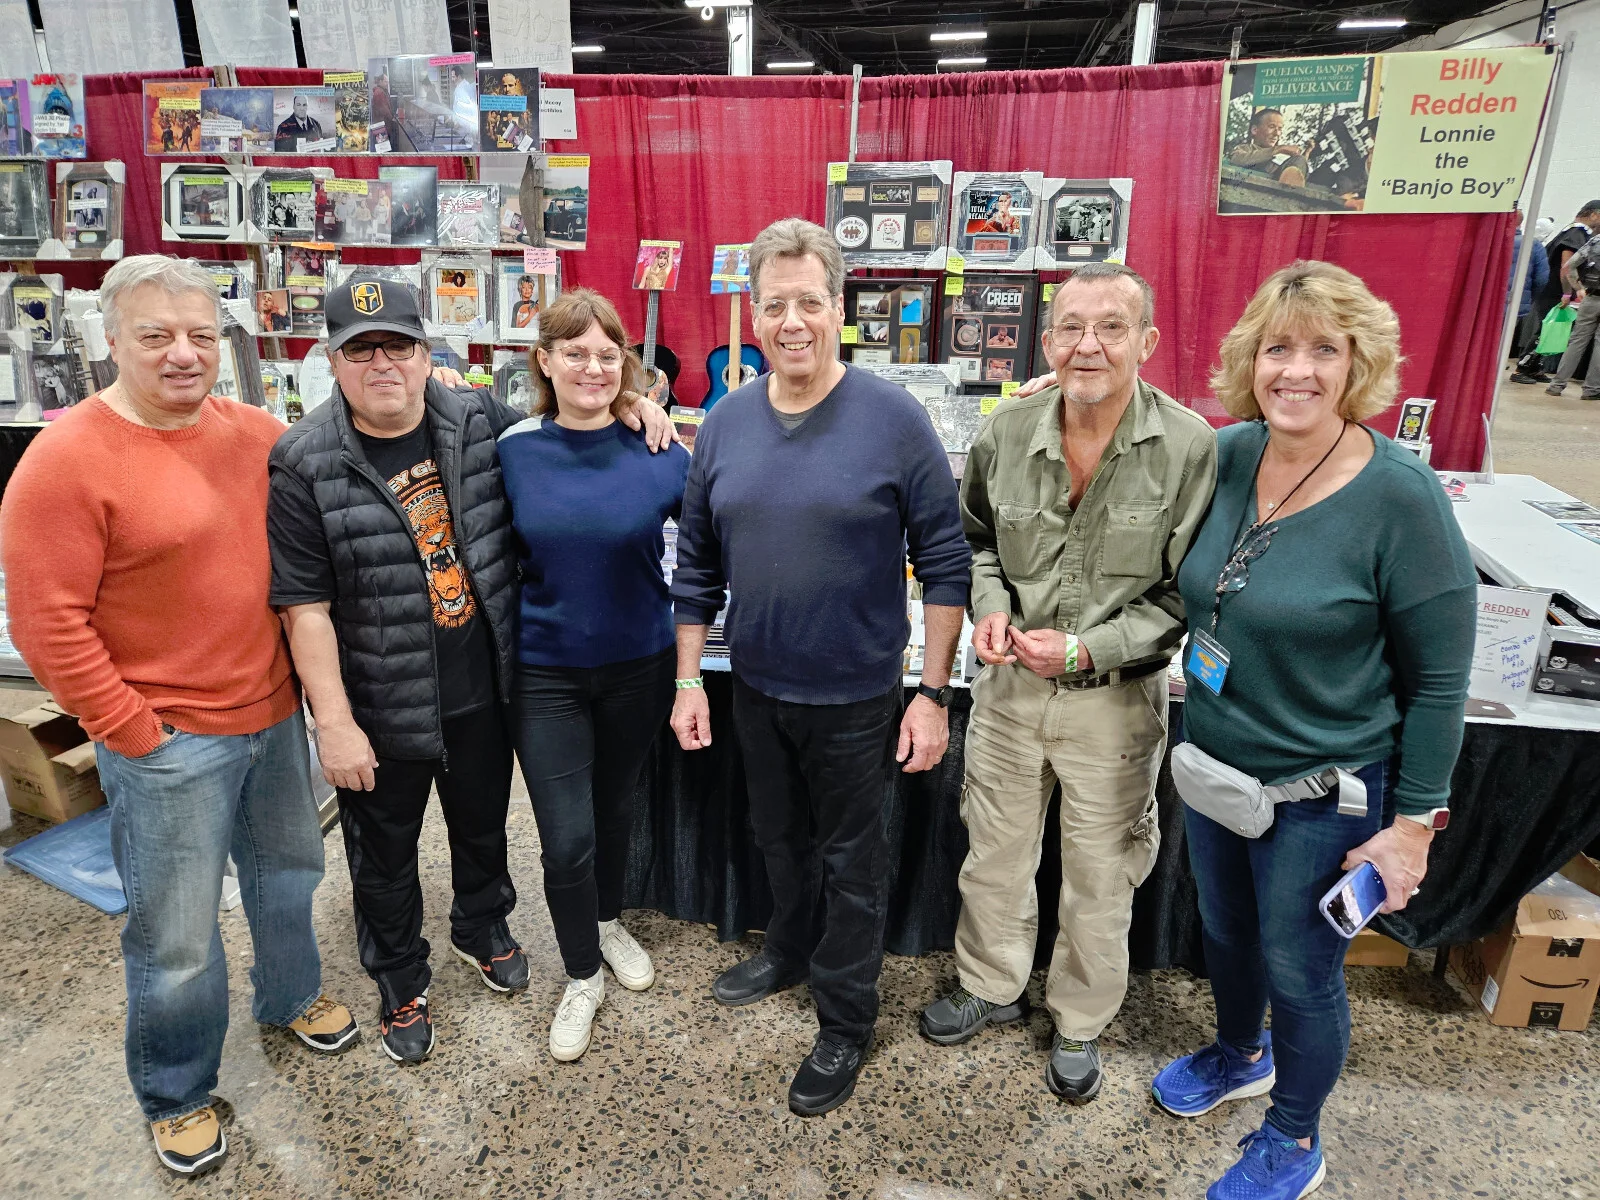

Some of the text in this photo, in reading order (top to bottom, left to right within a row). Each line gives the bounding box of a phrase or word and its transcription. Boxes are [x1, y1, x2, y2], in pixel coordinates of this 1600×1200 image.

[1439, 57, 1503, 85] Billy
[1261, 80, 1354, 96] DELIVERANCE
[1410, 92, 1517, 116] Redden
[1419, 124, 1496, 143] Lonnie
[1435, 152, 1469, 169] the
[1381, 177, 1515, 199] “Banjo Boy”
[986, 291, 1021, 306] CREED
[1483, 602, 1531, 617] REDDEN
[1502, 653, 1520, 665] Photo
[1511, 680, 1525, 690] $20
[1548, 908, 1568, 921] 130
